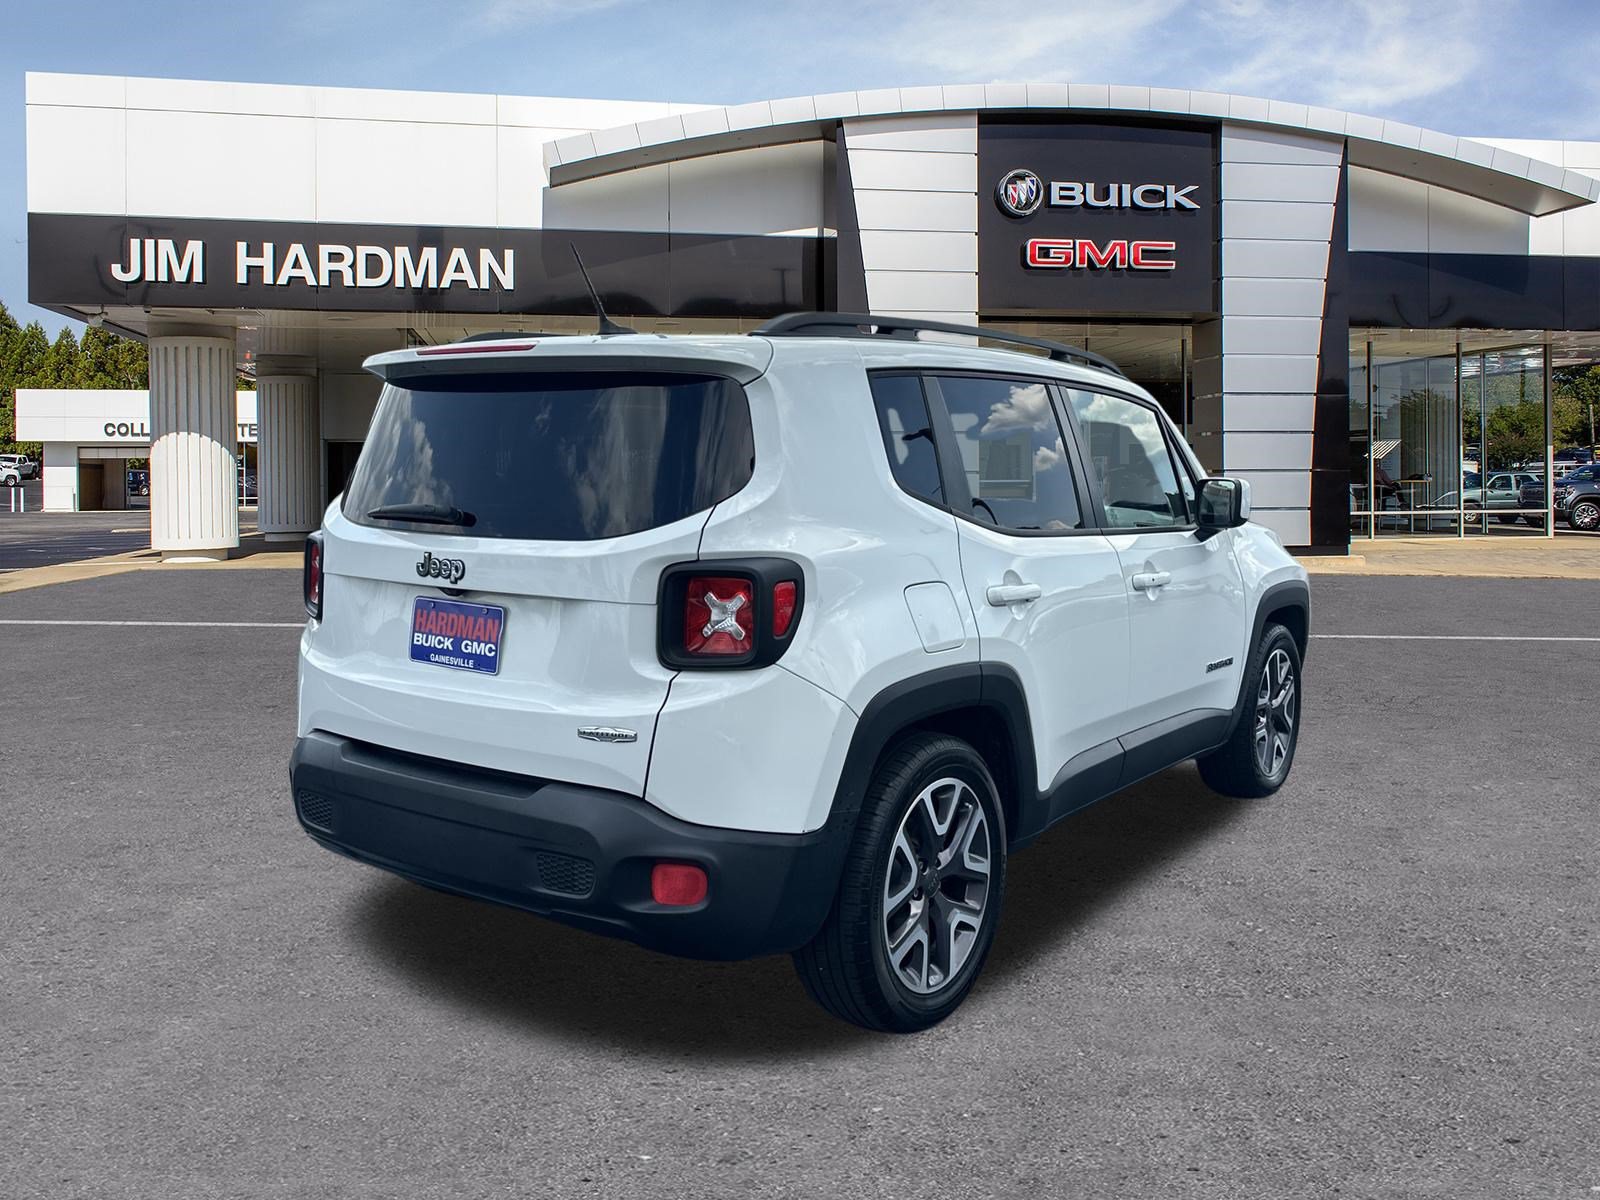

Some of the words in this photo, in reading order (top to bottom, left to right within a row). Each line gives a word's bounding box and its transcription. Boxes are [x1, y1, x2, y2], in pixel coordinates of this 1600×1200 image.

[1050, 181, 1200, 209] BUICK
[111, 238, 204, 284] JIM
[236, 241, 515, 291] HARDMAN
[1026, 238, 1177, 270] GMC
[416, 551, 466, 585] Jeep
[415, 608, 500, 642] HARDMAN
[413, 632, 454, 651] BUICK
[461, 640, 496, 657] GMC
[430, 653, 474, 668] GAINESVILLE
